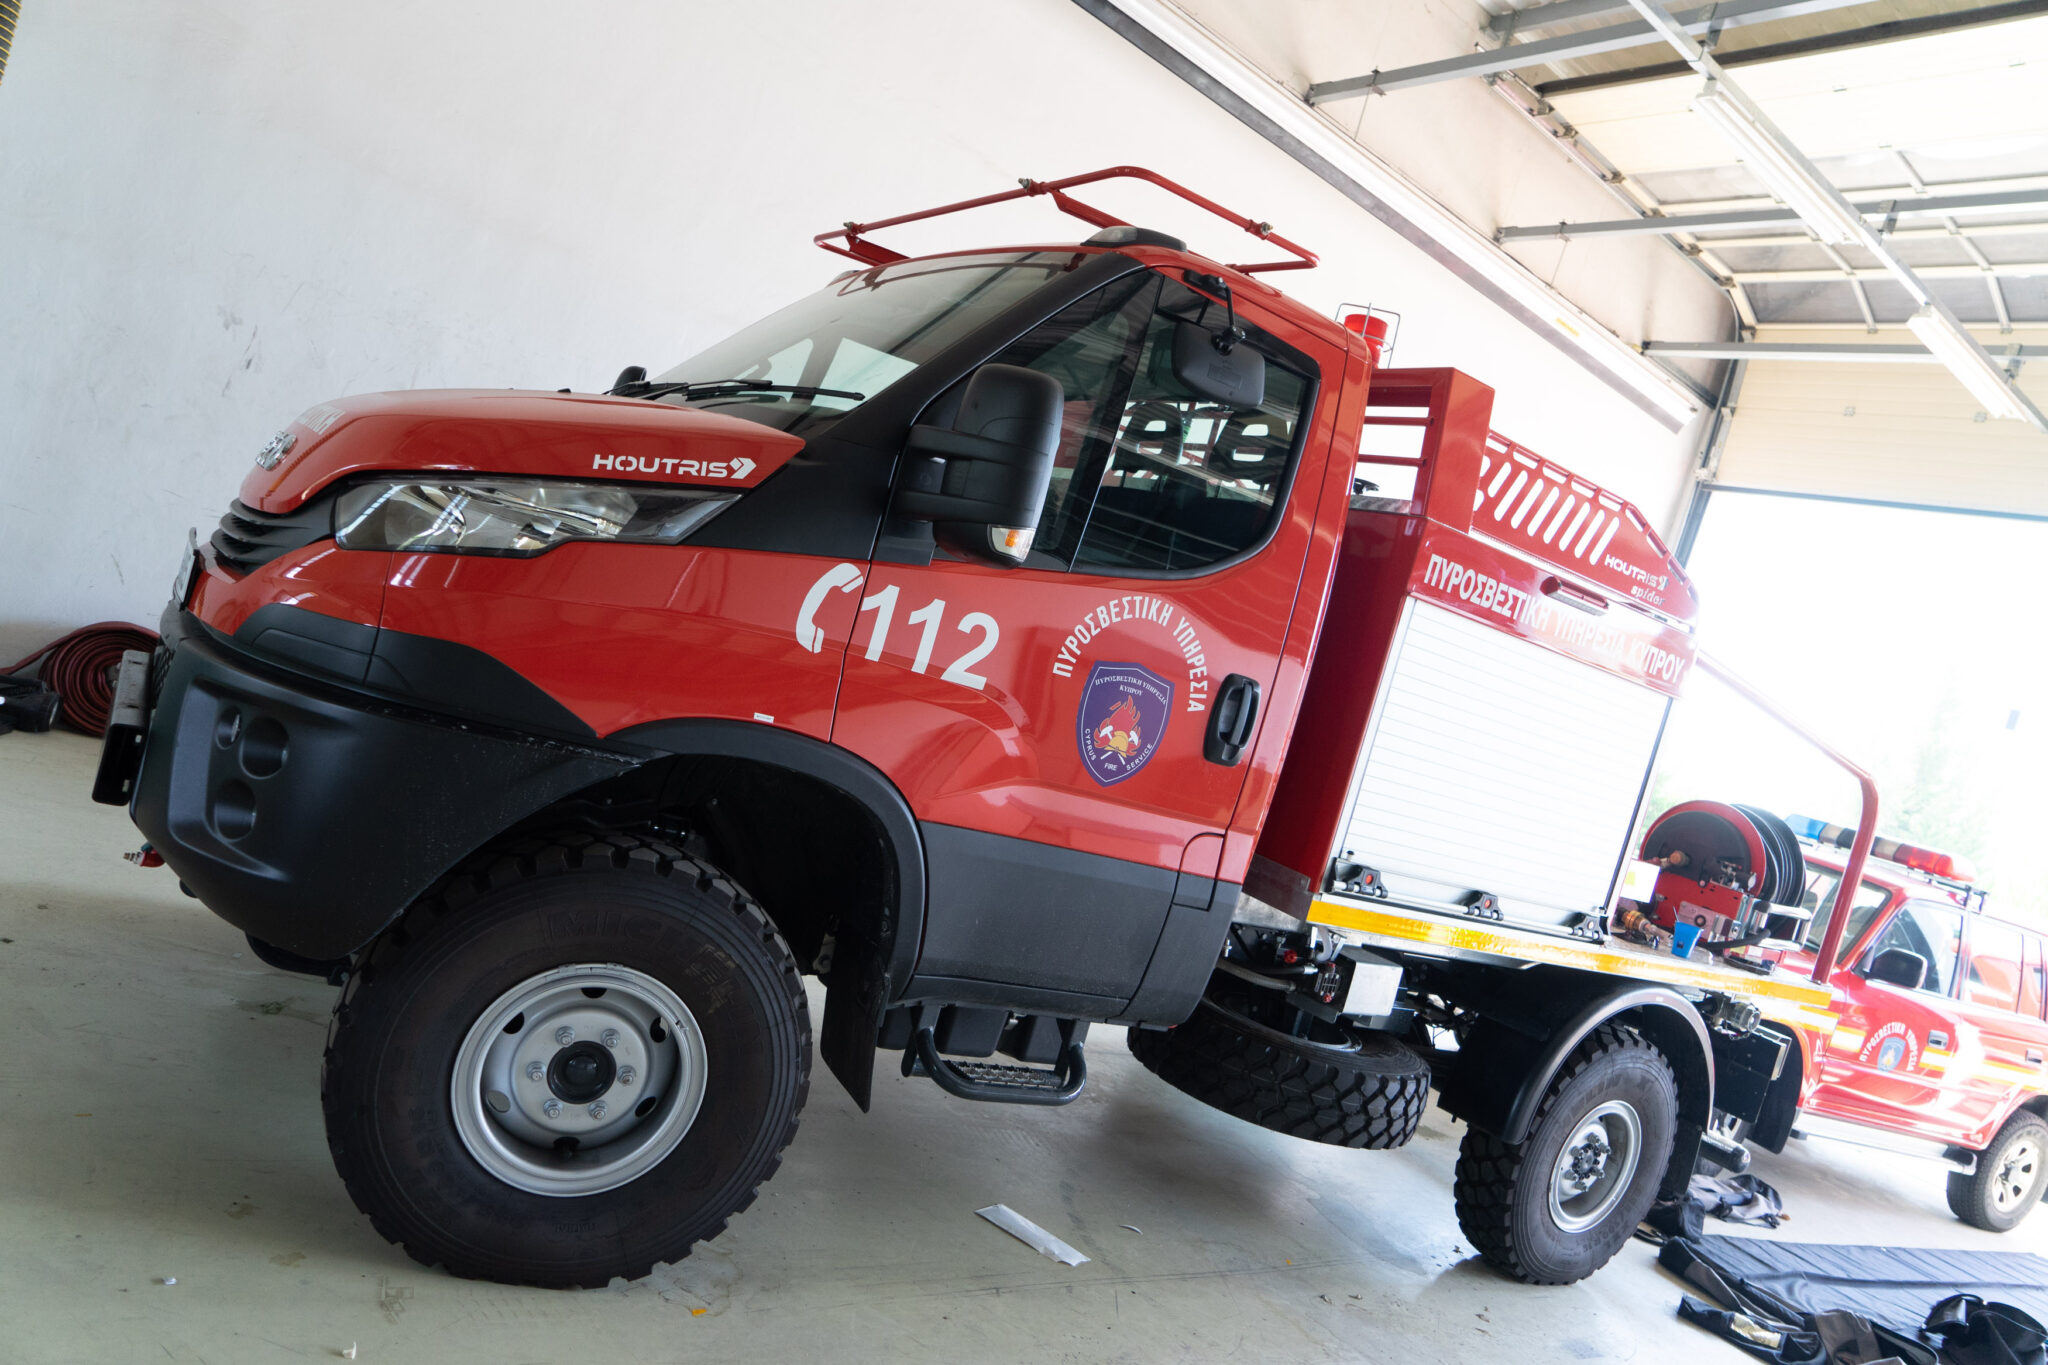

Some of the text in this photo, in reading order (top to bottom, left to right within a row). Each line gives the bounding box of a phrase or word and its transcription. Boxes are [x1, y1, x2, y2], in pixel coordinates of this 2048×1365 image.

[592, 454, 728, 479] HOUTRIS
[1604, 553, 1659, 588] HOUTRIS
[1630, 585, 1665, 607] spider
[860, 584, 1000, 691] 112
[1423, 553, 1550, 633] ΠΥΡΟΣΒΕΣΤΙΚΗ
[1627, 637, 1686, 684] ΚΥΠΡΟΥ
[1052, 596, 1208, 713] ΠΥΡΟΣΒΕΣΤΙΚΗ ΥΠΗΡΕΣΙΑ
[1085, 728, 1153, 771] CYPRUS FIRE SERVICE
